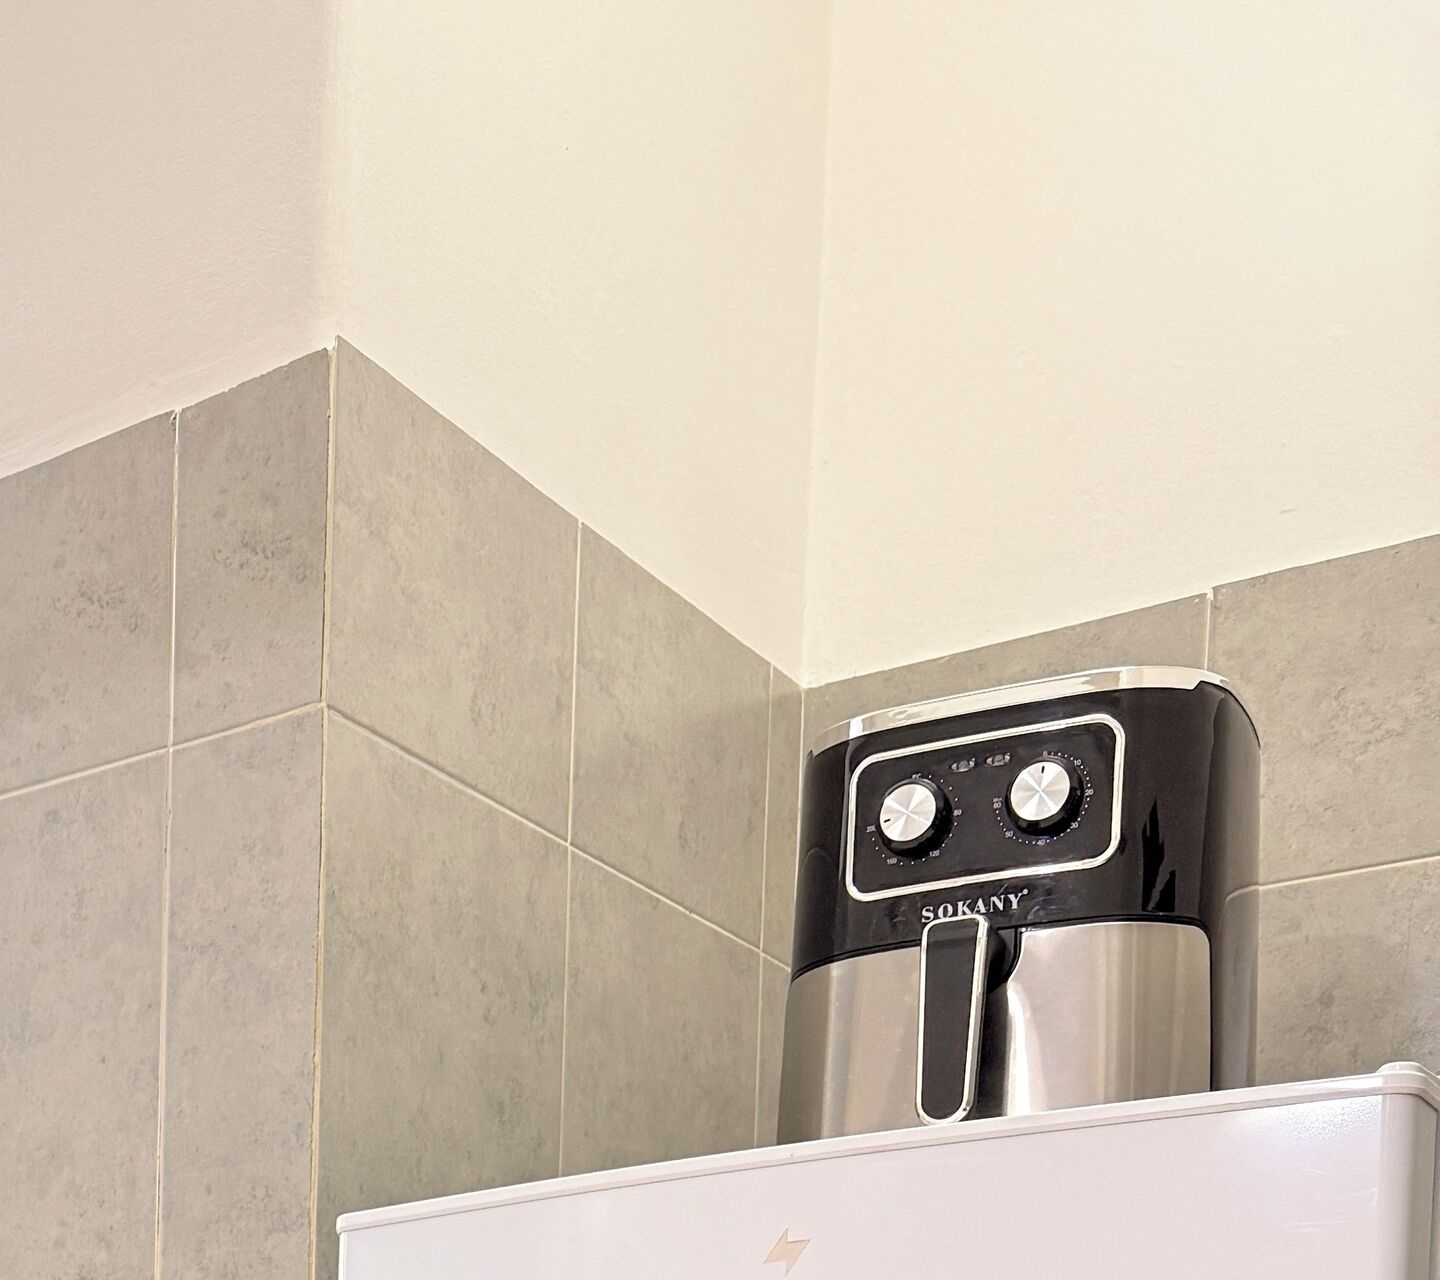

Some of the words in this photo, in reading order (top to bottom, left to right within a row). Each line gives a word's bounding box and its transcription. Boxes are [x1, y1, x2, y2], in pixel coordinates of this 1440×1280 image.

[1073, 758, 1082, 766] 10
[1085, 788, 1094, 796] 20
[1036, 838, 1046, 846] 40
[921, 893, 1023, 923] SOKANY
